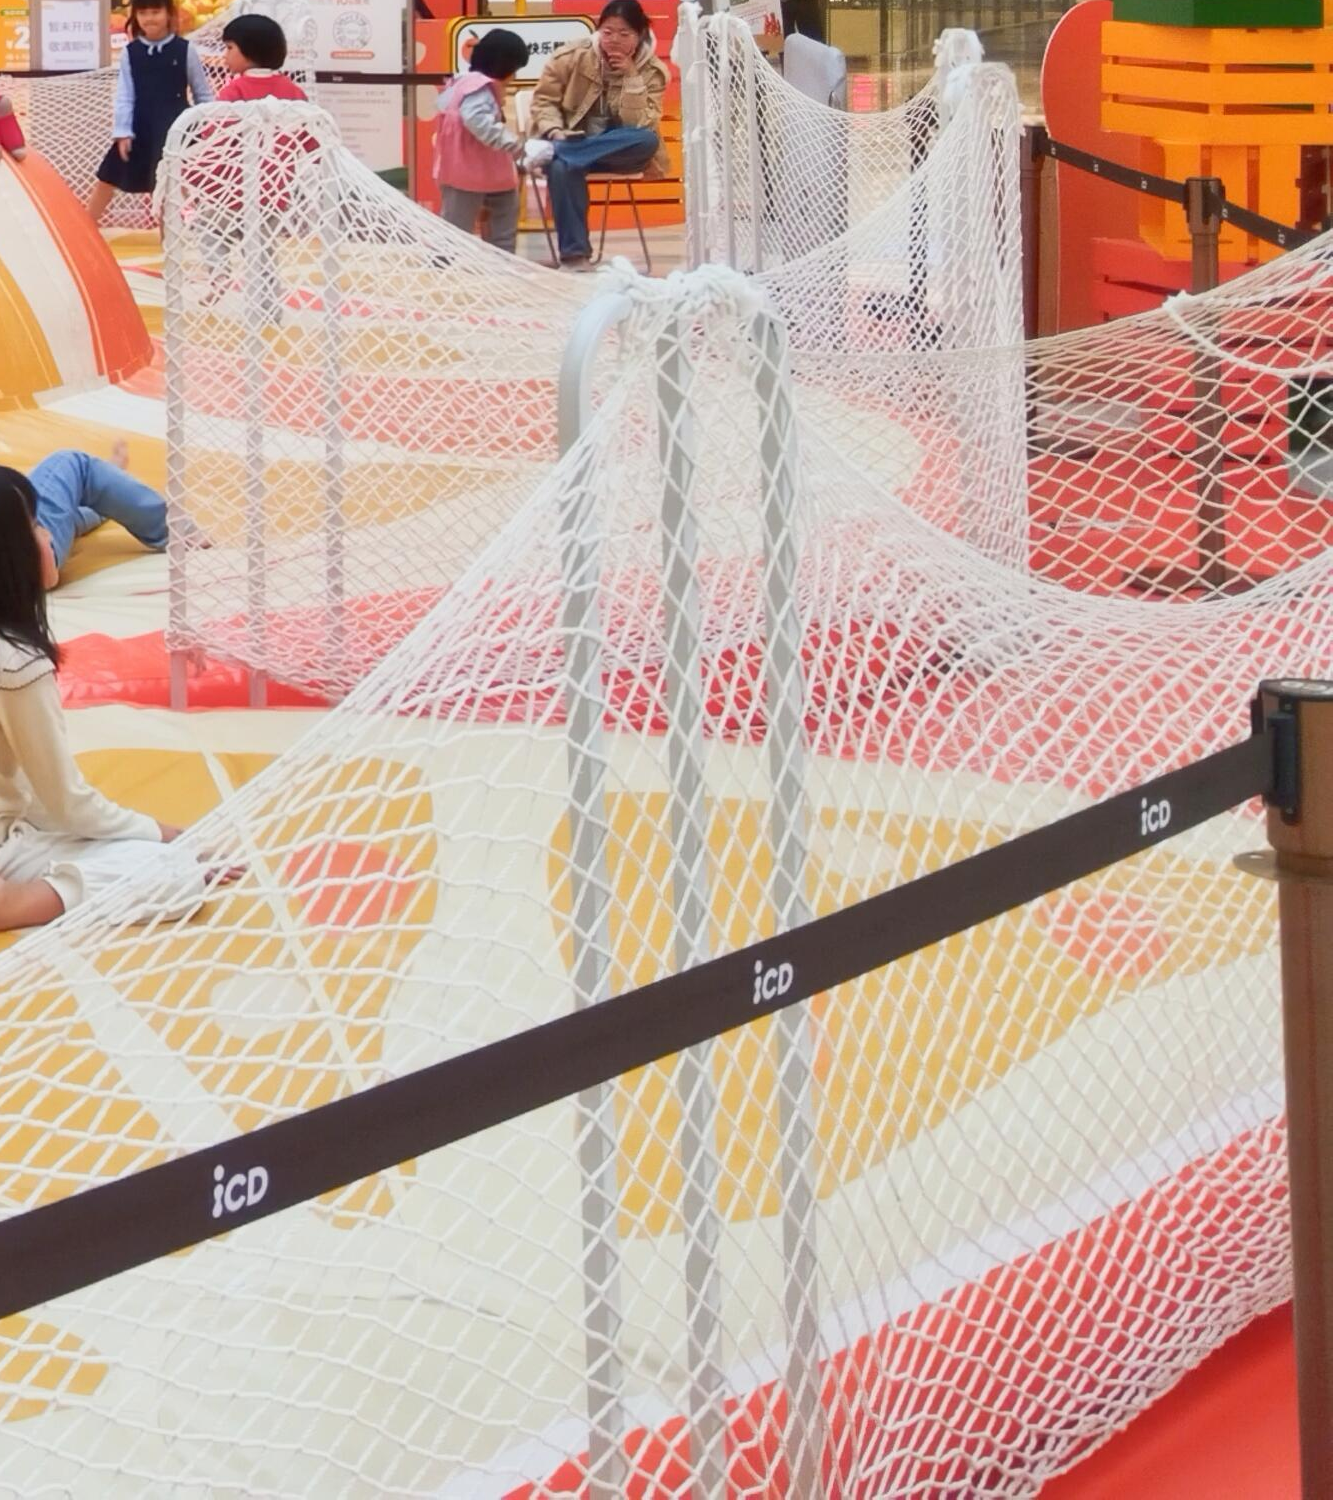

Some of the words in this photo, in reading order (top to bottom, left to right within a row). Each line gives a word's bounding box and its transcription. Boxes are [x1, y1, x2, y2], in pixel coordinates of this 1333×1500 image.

[1141, 797, 1171, 836] iCD
[753, 959, 793, 1005] iCD
[212, 1164, 269, 1219] iCD
